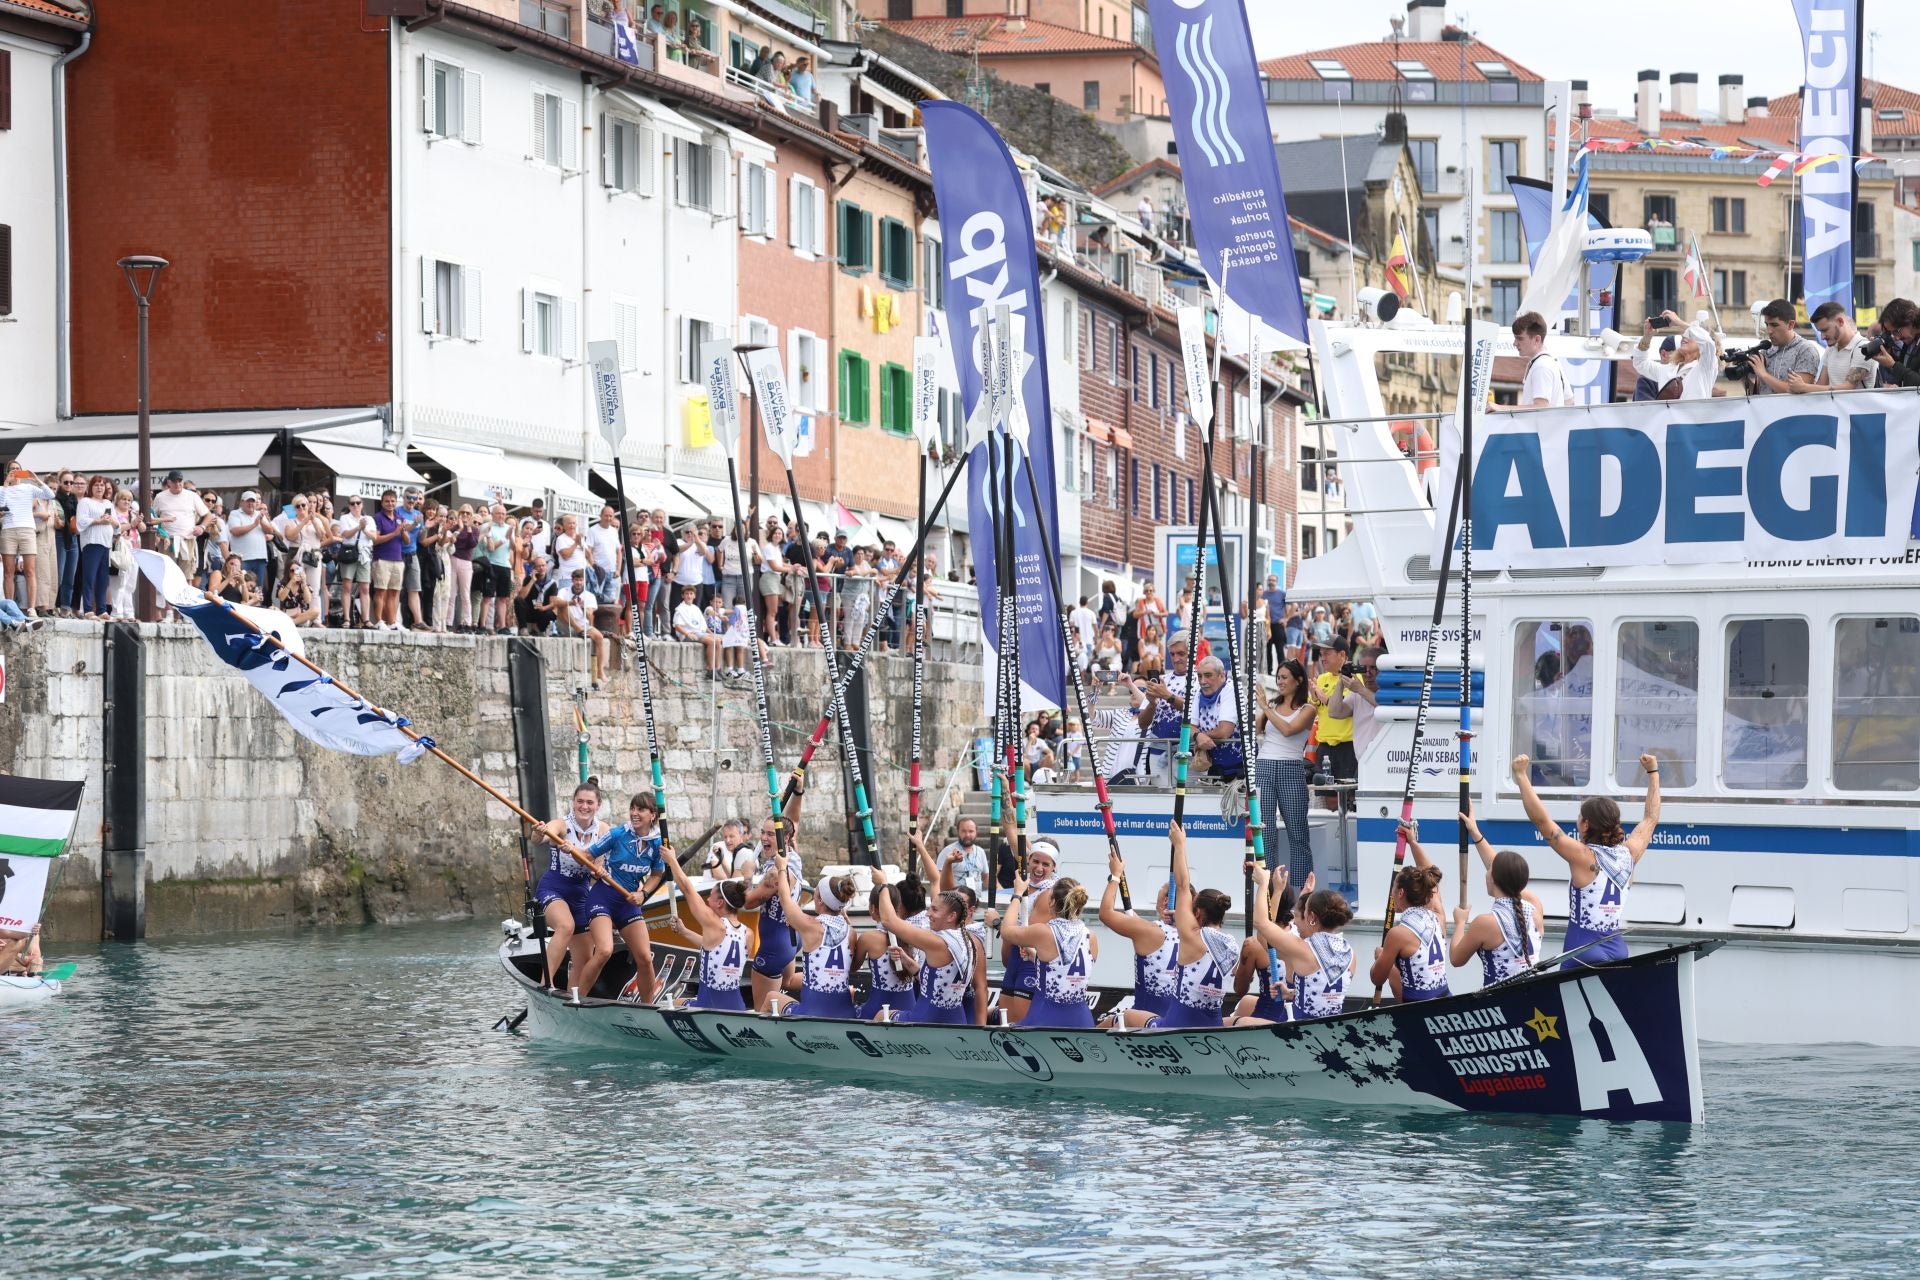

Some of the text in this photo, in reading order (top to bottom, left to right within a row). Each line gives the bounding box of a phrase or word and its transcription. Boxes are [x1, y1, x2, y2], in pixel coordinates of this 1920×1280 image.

[713, 358, 725, 408] BAVIERA
[1469, 338, 1485, 396] BAVIERA
[602, 374, 615, 424] BAVIERA
[609, 373, 619, 409] CLINICA
[709, 374, 719, 409] CLINICA
[766, 381, 785, 434] BAVIERA
[773, 380, 788, 417] CLINICA
[1453, 413, 1888, 550] ADEGI
[825, 581, 900, 718] DONSTIA ARRAUN LAGUNAK
[753, 661, 765, 704] ARRAUN
[818, 622, 862, 781] DONOSTIA ARRAUN LAGUNAK
[759, 707, 773, 762] DONOSTIA
[1387, 750, 1412, 762] CIUDA
[1054, 817, 1074, 828] ¡Sube
[1080, 818, 1100, 828] bordo
[1123, 819, 1129, 828] el
[1130, 821, 1145, 829] mar
[1146, 820, 1155, 829] de
[1155, 822, 1168, 830] una
[1193, 821, 1228, 831] diferente!
[768, 895, 780, 921] asegi
[1570, 886, 1579, 924] asegi
[723, 940, 740, 968] A
[920, 966, 930, 998] asegi
[1424, 1006, 1507, 1035] ARRAUN
[1534, 1019, 1552, 1033] 11
[873, 1040, 932, 1058] Edyma
[945, 1046, 1000, 1062] Lurauto
[1126, 1040, 1183, 1064] asegi
[1435, 1027, 1531, 1056] LAGUNAK
[1559, 975, 1664, 1112] A
[1159, 1064, 1192, 1077] grupo
[1447, 1049, 1551, 1077] DONOSTIA
[1458, 1073, 1547, 1097] Lugañene
